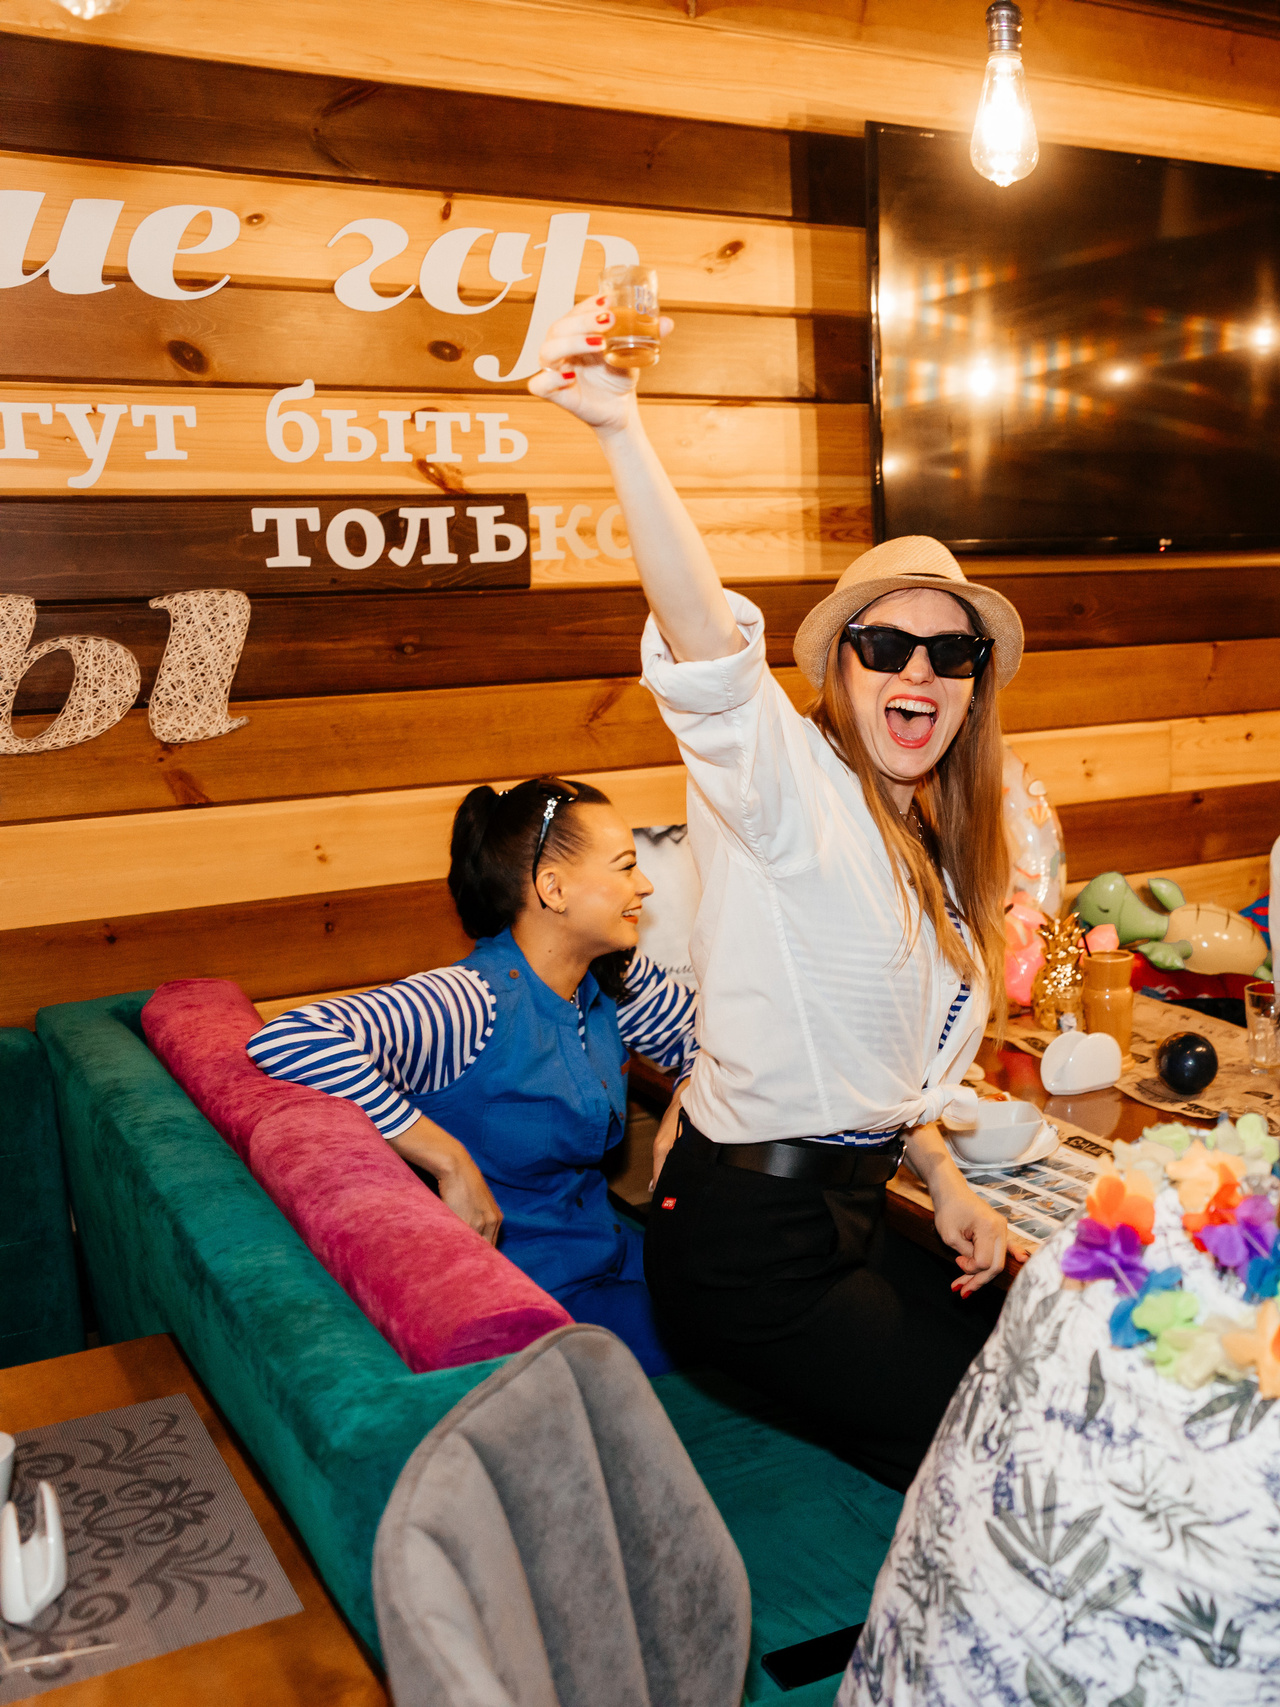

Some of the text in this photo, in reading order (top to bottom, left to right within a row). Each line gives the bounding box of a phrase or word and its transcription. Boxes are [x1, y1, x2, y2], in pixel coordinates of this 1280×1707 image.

[326, 212, 640, 383] гор
[0, 378, 530, 490] гут быть
